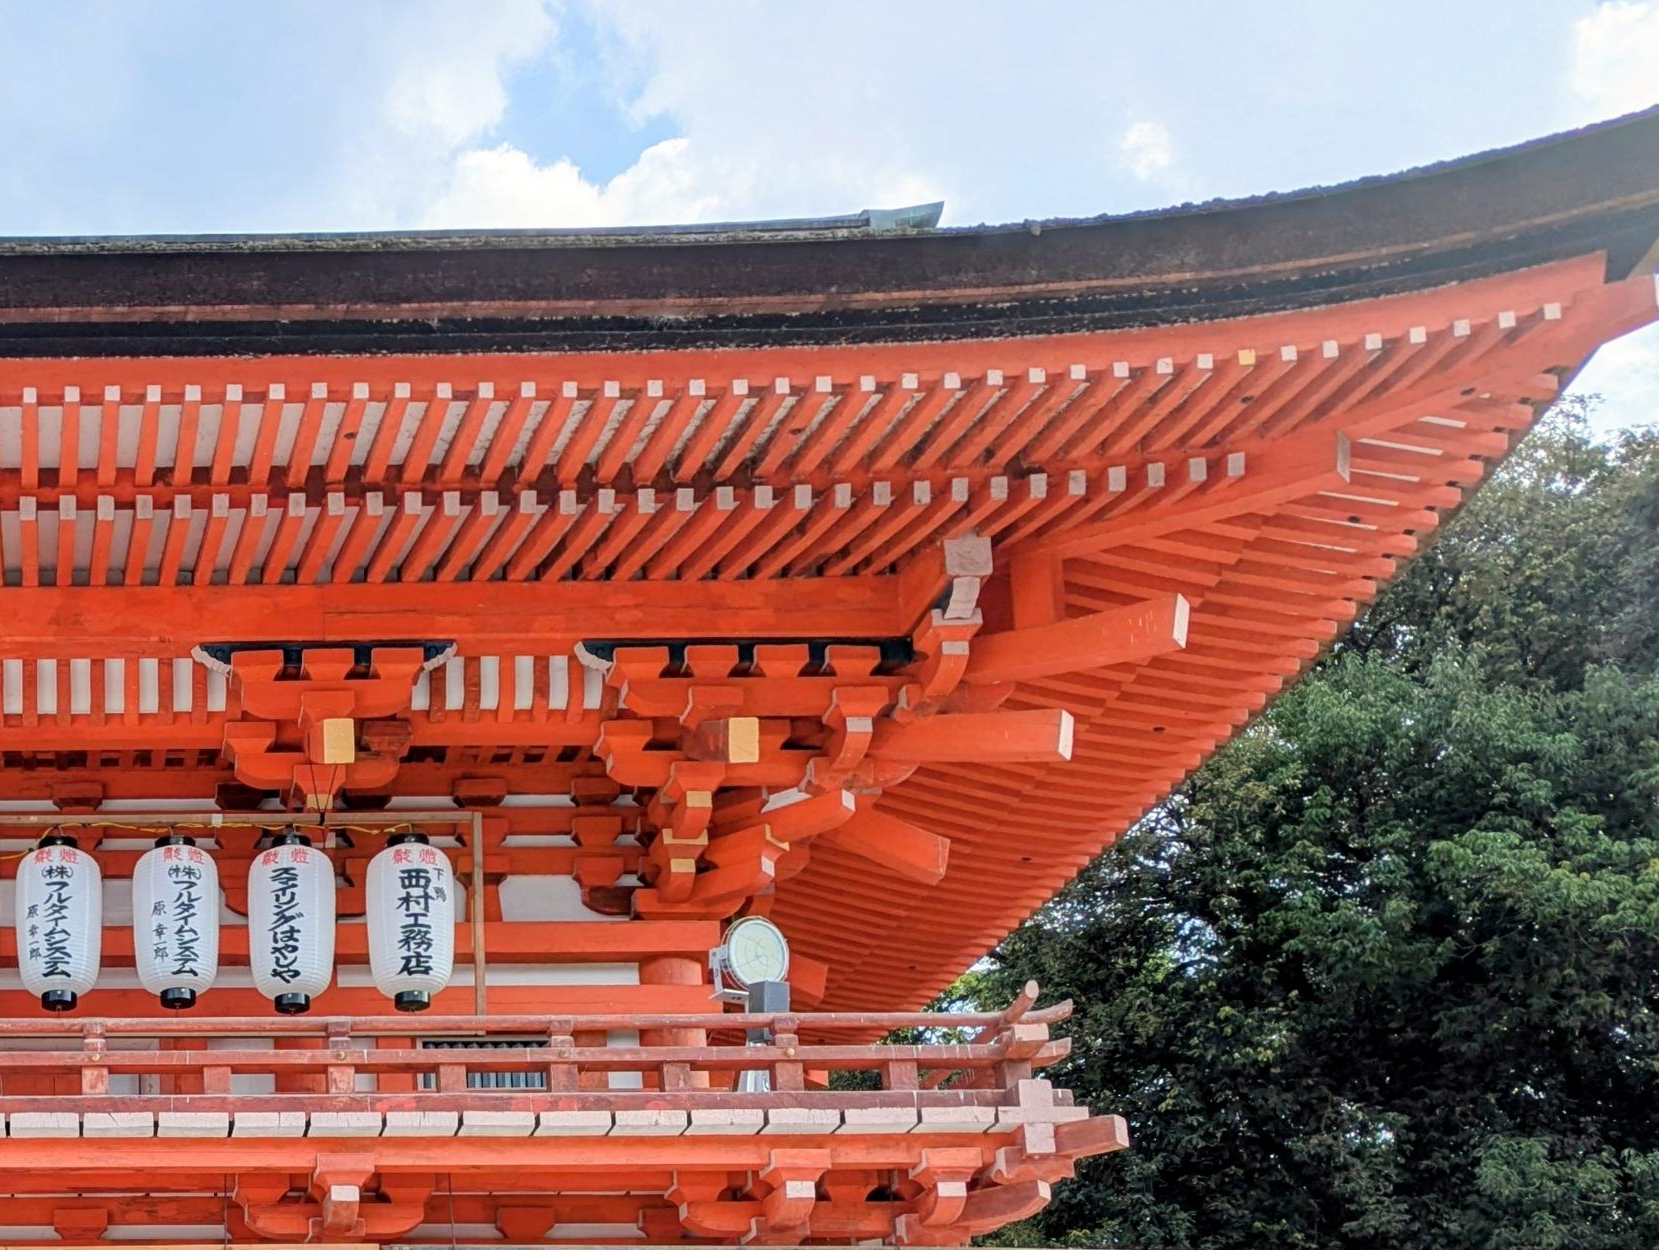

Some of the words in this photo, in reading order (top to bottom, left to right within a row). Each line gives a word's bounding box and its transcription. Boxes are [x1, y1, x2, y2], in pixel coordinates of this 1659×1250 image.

[396, 868, 438, 976] 西村工務店
